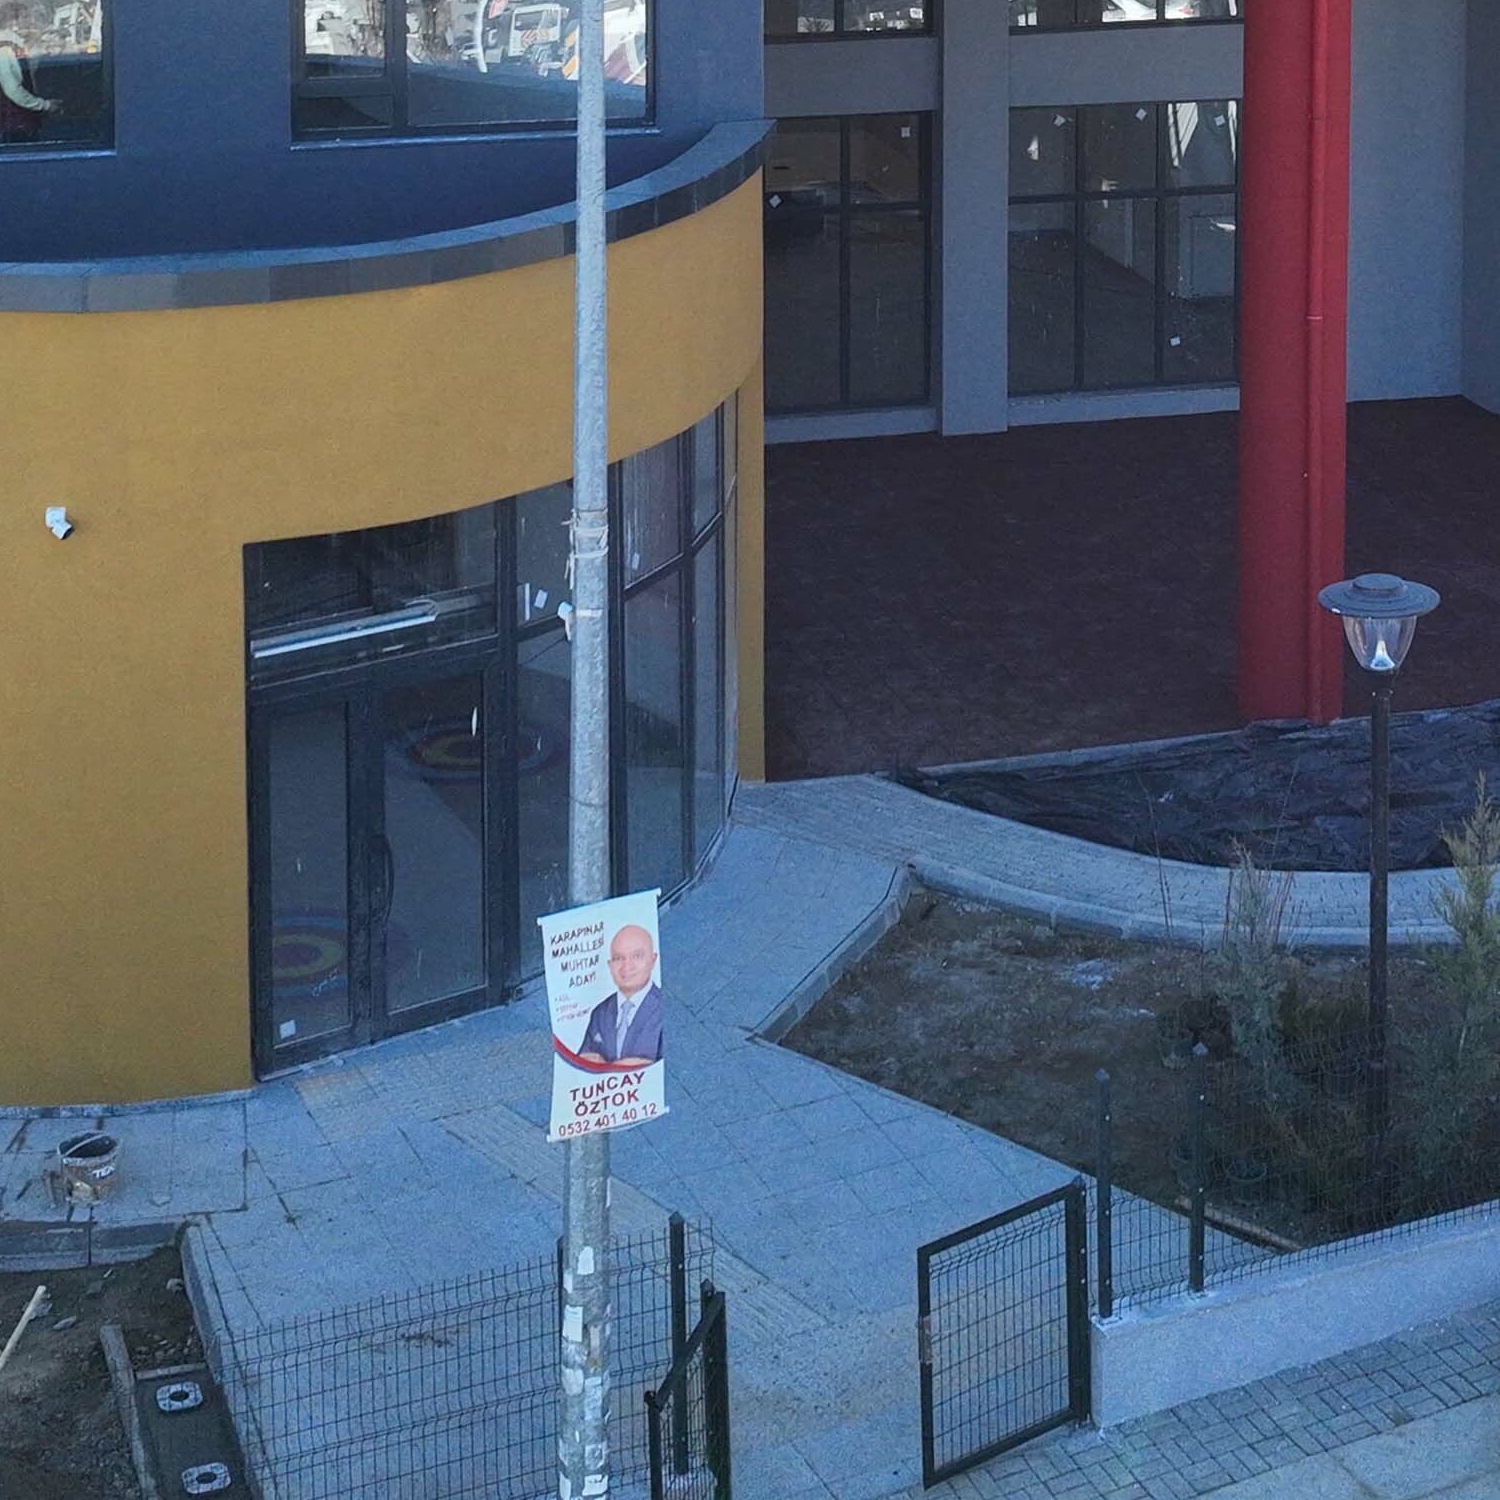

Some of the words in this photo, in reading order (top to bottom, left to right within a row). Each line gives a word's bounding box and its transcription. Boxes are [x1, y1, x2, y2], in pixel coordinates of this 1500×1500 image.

[550, 921, 604, 946] KARAPINAR
[560, 954, 600, 972] MUHTAR
[570, 1071, 645, 1102] TUNCAY
[575, 1089, 640, 1117] ÖZTOK
[558, 1119, 591, 1137] 0532
[594, 1113, 617, 1128] 401
[622, 1107, 637, 1120] 40
[642, 1102, 657, 1116] 12
